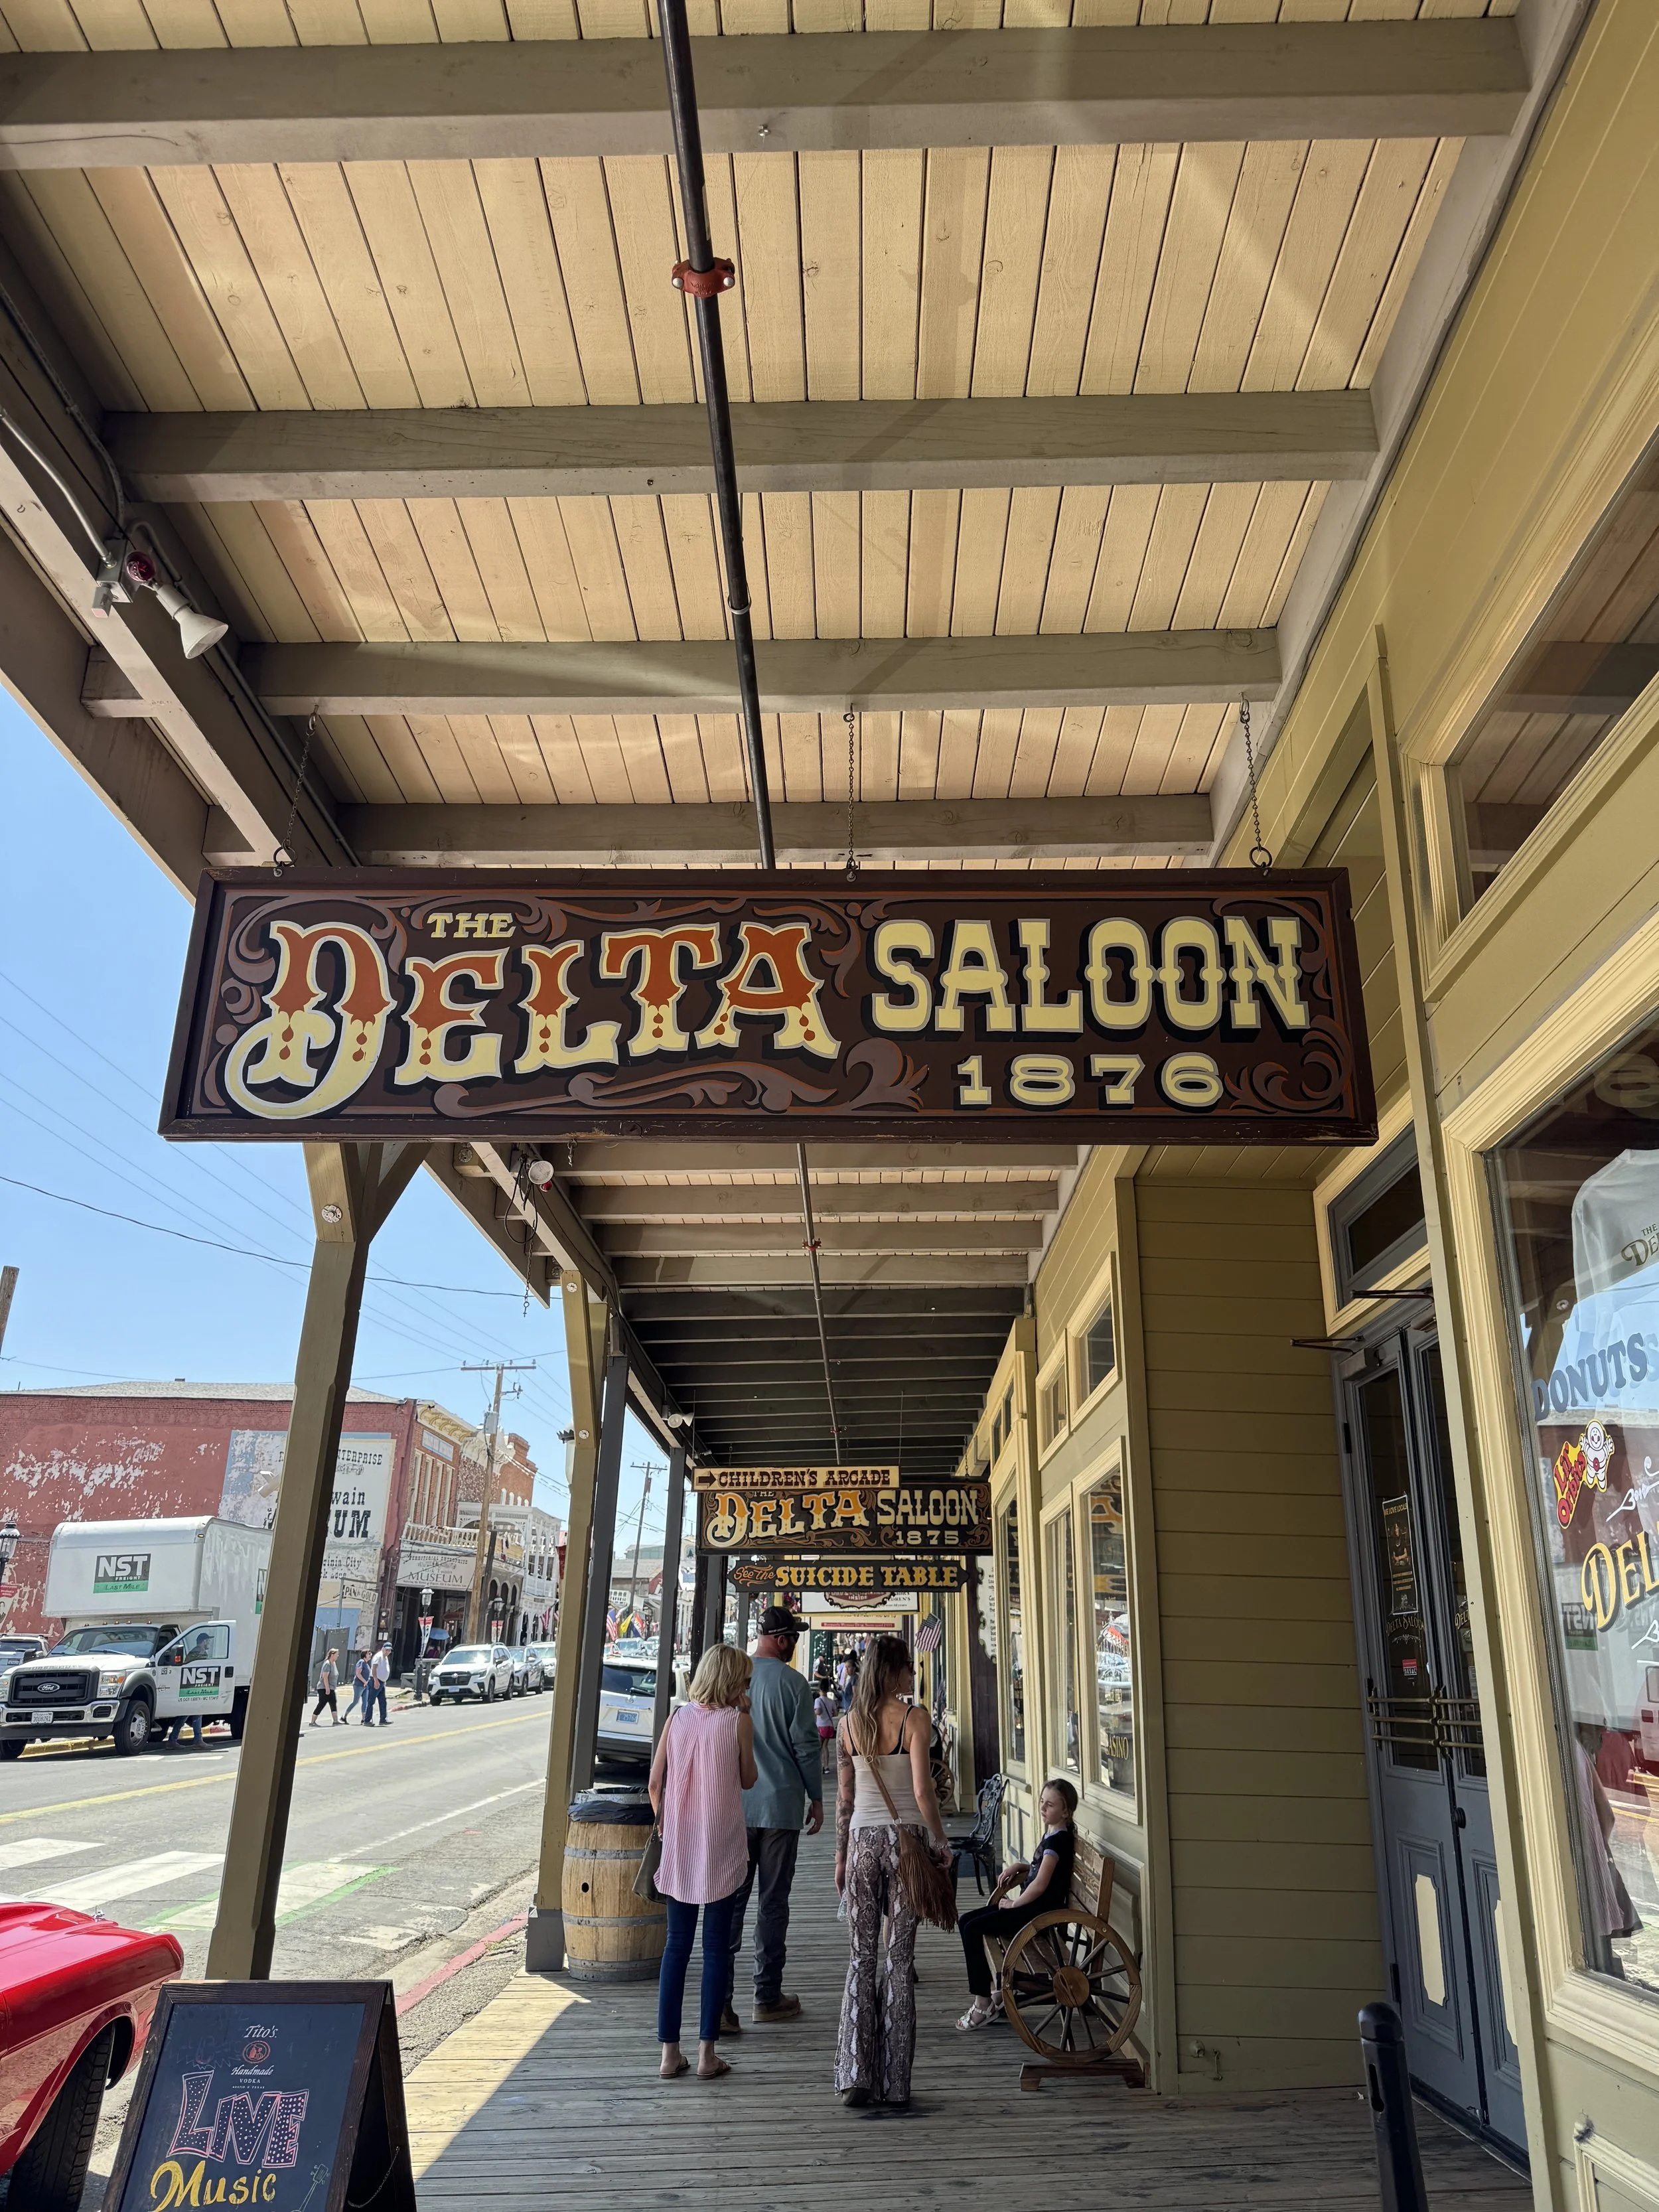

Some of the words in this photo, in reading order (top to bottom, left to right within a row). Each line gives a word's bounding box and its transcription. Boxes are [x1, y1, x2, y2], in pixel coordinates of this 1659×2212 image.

[427, 913, 516, 938] THE
[224, 921, 841, 1119] DELTA
[872, 916, 1310, 1032] SALOON
[956, 1052, 1224, 1106] 1876
[1641, 1224, 1658, 1236] THE
[1532, 1333, 1648, 1422] DONUTS
[337, 1449, 382, 1465] NTERPRISE
[717, 1468, 818, 1487] CHILDREN'S
[825, 1469, 891, 1487] ARCADE
[332, 1487, 366, 1505] wain
[706, 1491, 869, 1547] DELTA
[877, 1490, 979, 1525] SALOON
[896, 1530, 960, 1545] 1875
[98, 1556, 148, 1577] NST
[346, 1556, 362, 1570] City
[408, 1572, 463, 1584] MUSEUM
[734, 1567, 753, 1580] See
[775, 1566, 874, 1587] SUICIDE
[881, 1566, 958, 1587] TABLE
[1581, 1521, 1659, 1633] DEL
[362, 1589, 376, 1602] GOLD
[1386, 1617, 1402, 1637] DELTA
[1455, 1610, 1470, 1630] DELT
[182, 1667, 219, 1684] NST
[244, 2024, 278, 2038] Tito's
[231, 2065, 274, 2075] Handmade
[166, 2070, 309, 2168] LIVE
[148, 2161, 277, 2212] Music
